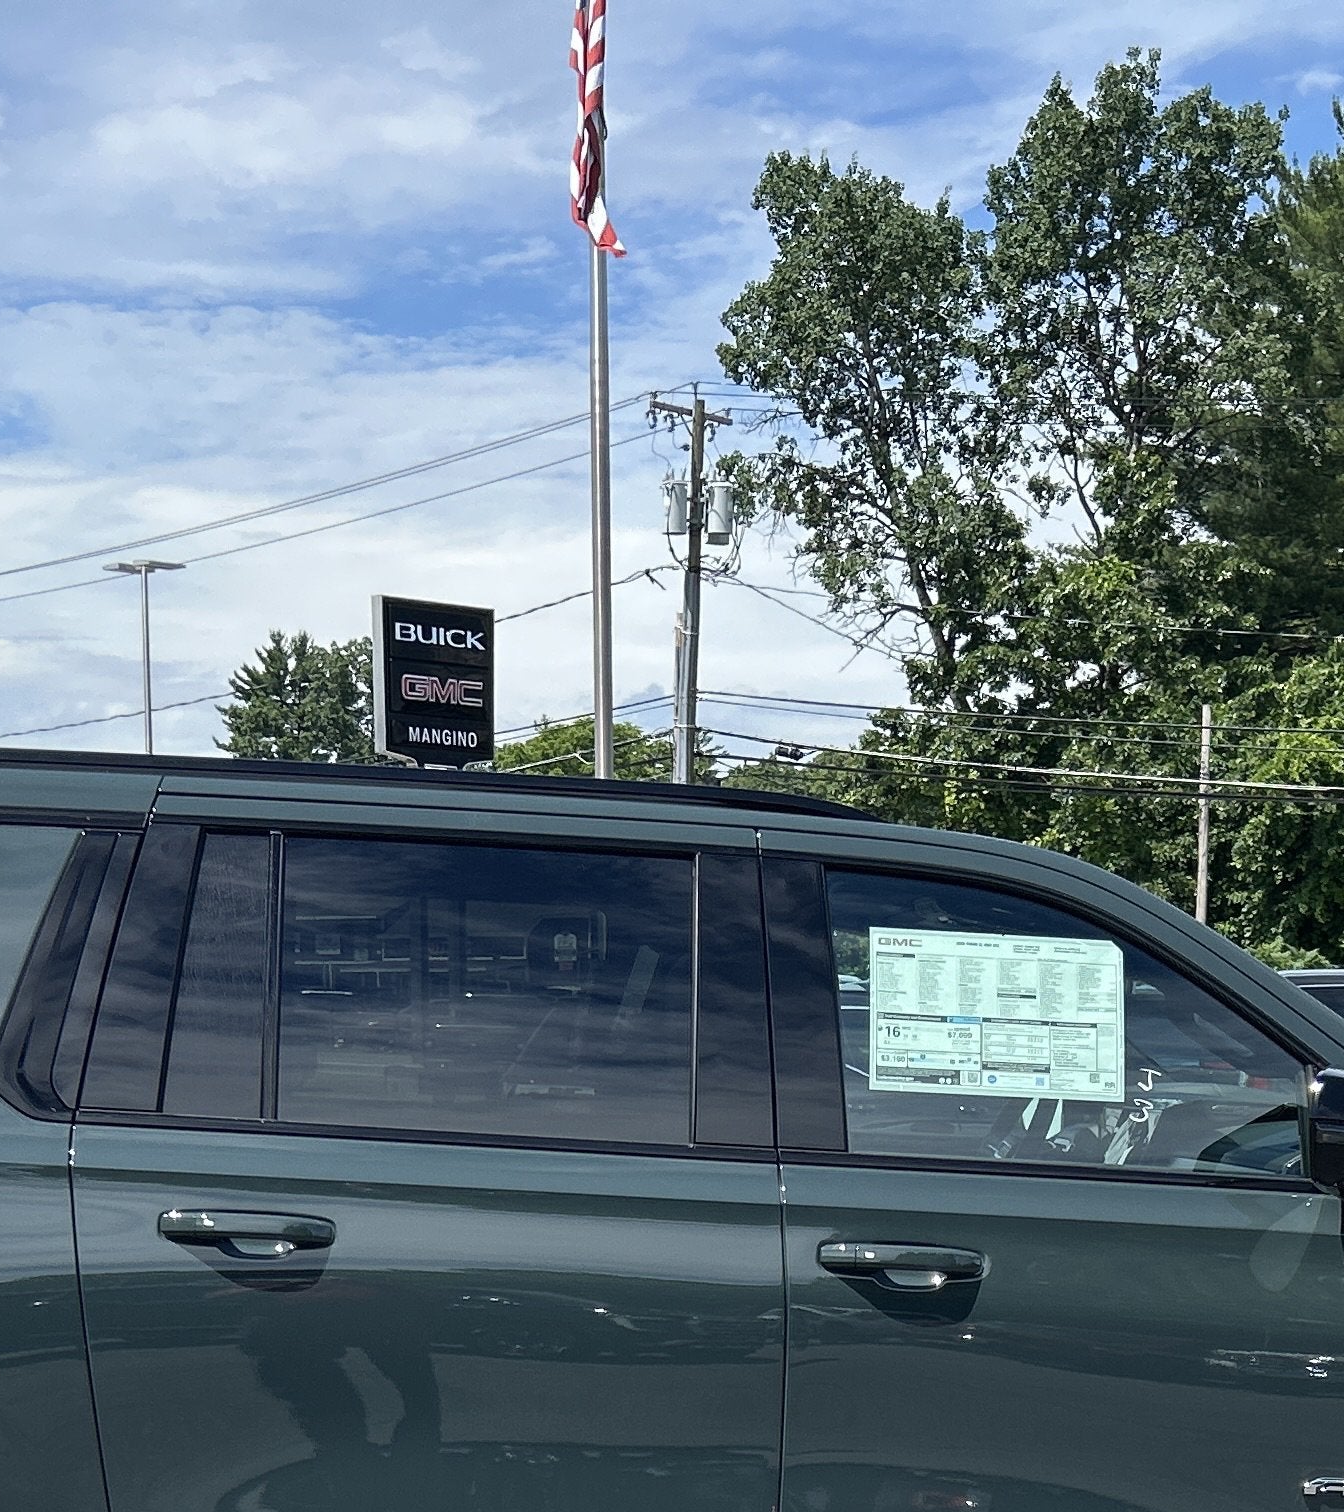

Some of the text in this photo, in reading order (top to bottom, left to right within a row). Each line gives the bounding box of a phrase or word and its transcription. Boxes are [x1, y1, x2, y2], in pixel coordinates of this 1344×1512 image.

[394, 622, 486, 651] BUICK
[401, 673, 483, 708] GMC
[408, 726, 478, 748] MANGINO
[878, 937, 923, 947] GMC
[884, 1025, 901, 1038] 16
